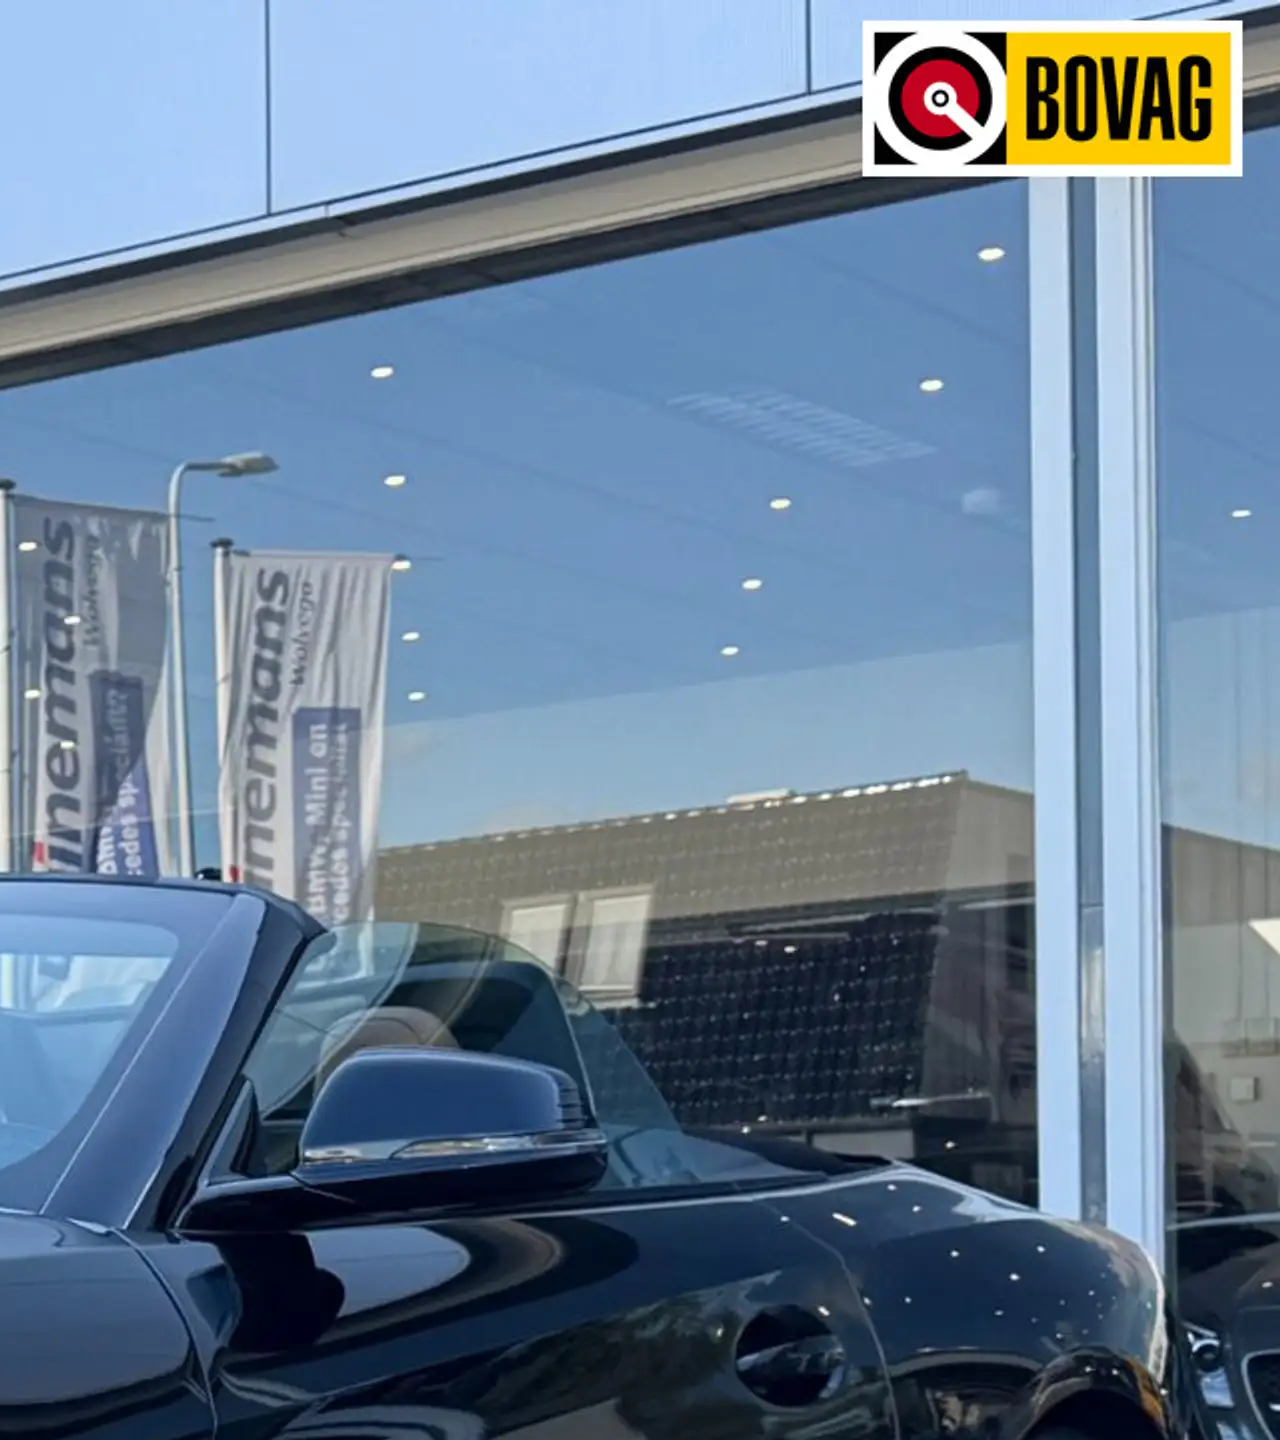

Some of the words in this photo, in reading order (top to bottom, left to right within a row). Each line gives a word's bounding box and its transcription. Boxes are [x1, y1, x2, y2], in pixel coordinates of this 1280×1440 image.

[309, 723, 329, 759] en
[304, 766, 329, 826] Mini
[328, 847, 352, 923] cedes
